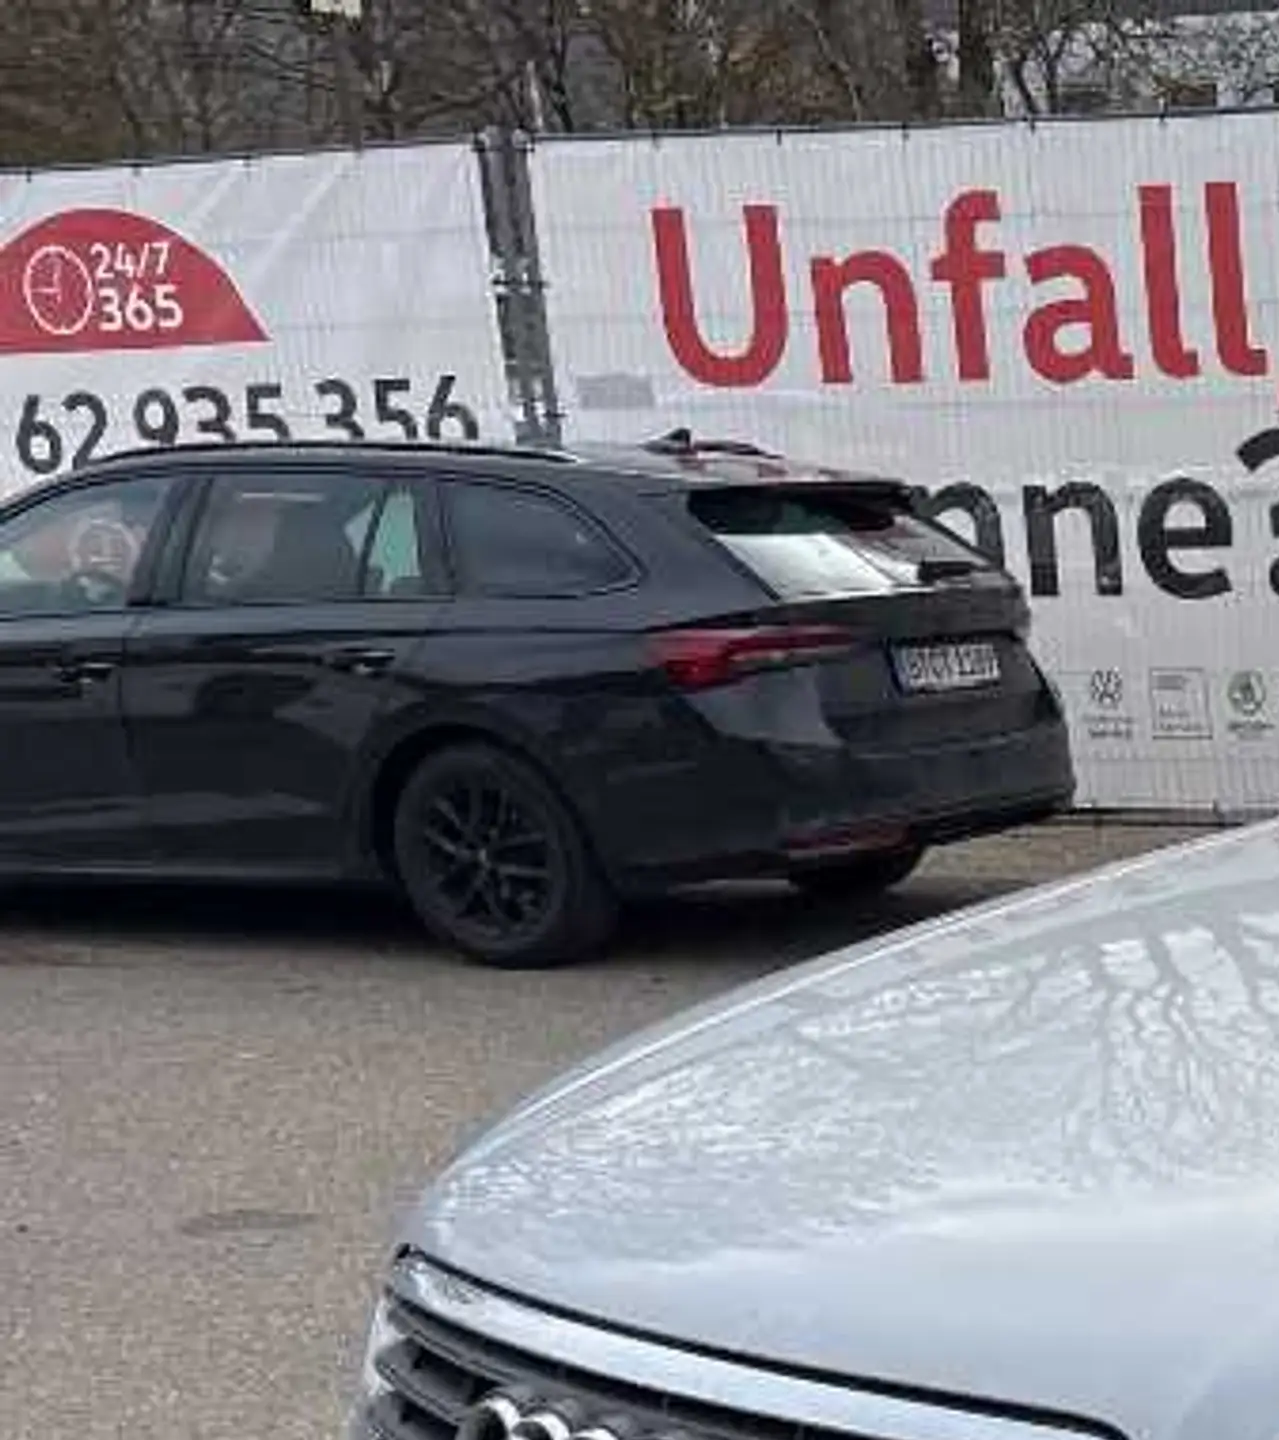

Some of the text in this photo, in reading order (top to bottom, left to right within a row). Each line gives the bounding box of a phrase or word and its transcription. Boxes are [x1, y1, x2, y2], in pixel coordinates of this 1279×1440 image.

[90, 242, 170, 278] 24/7
[98, 283, 184, 331] 365
[15, 375, 479, 474] 62 935 356
